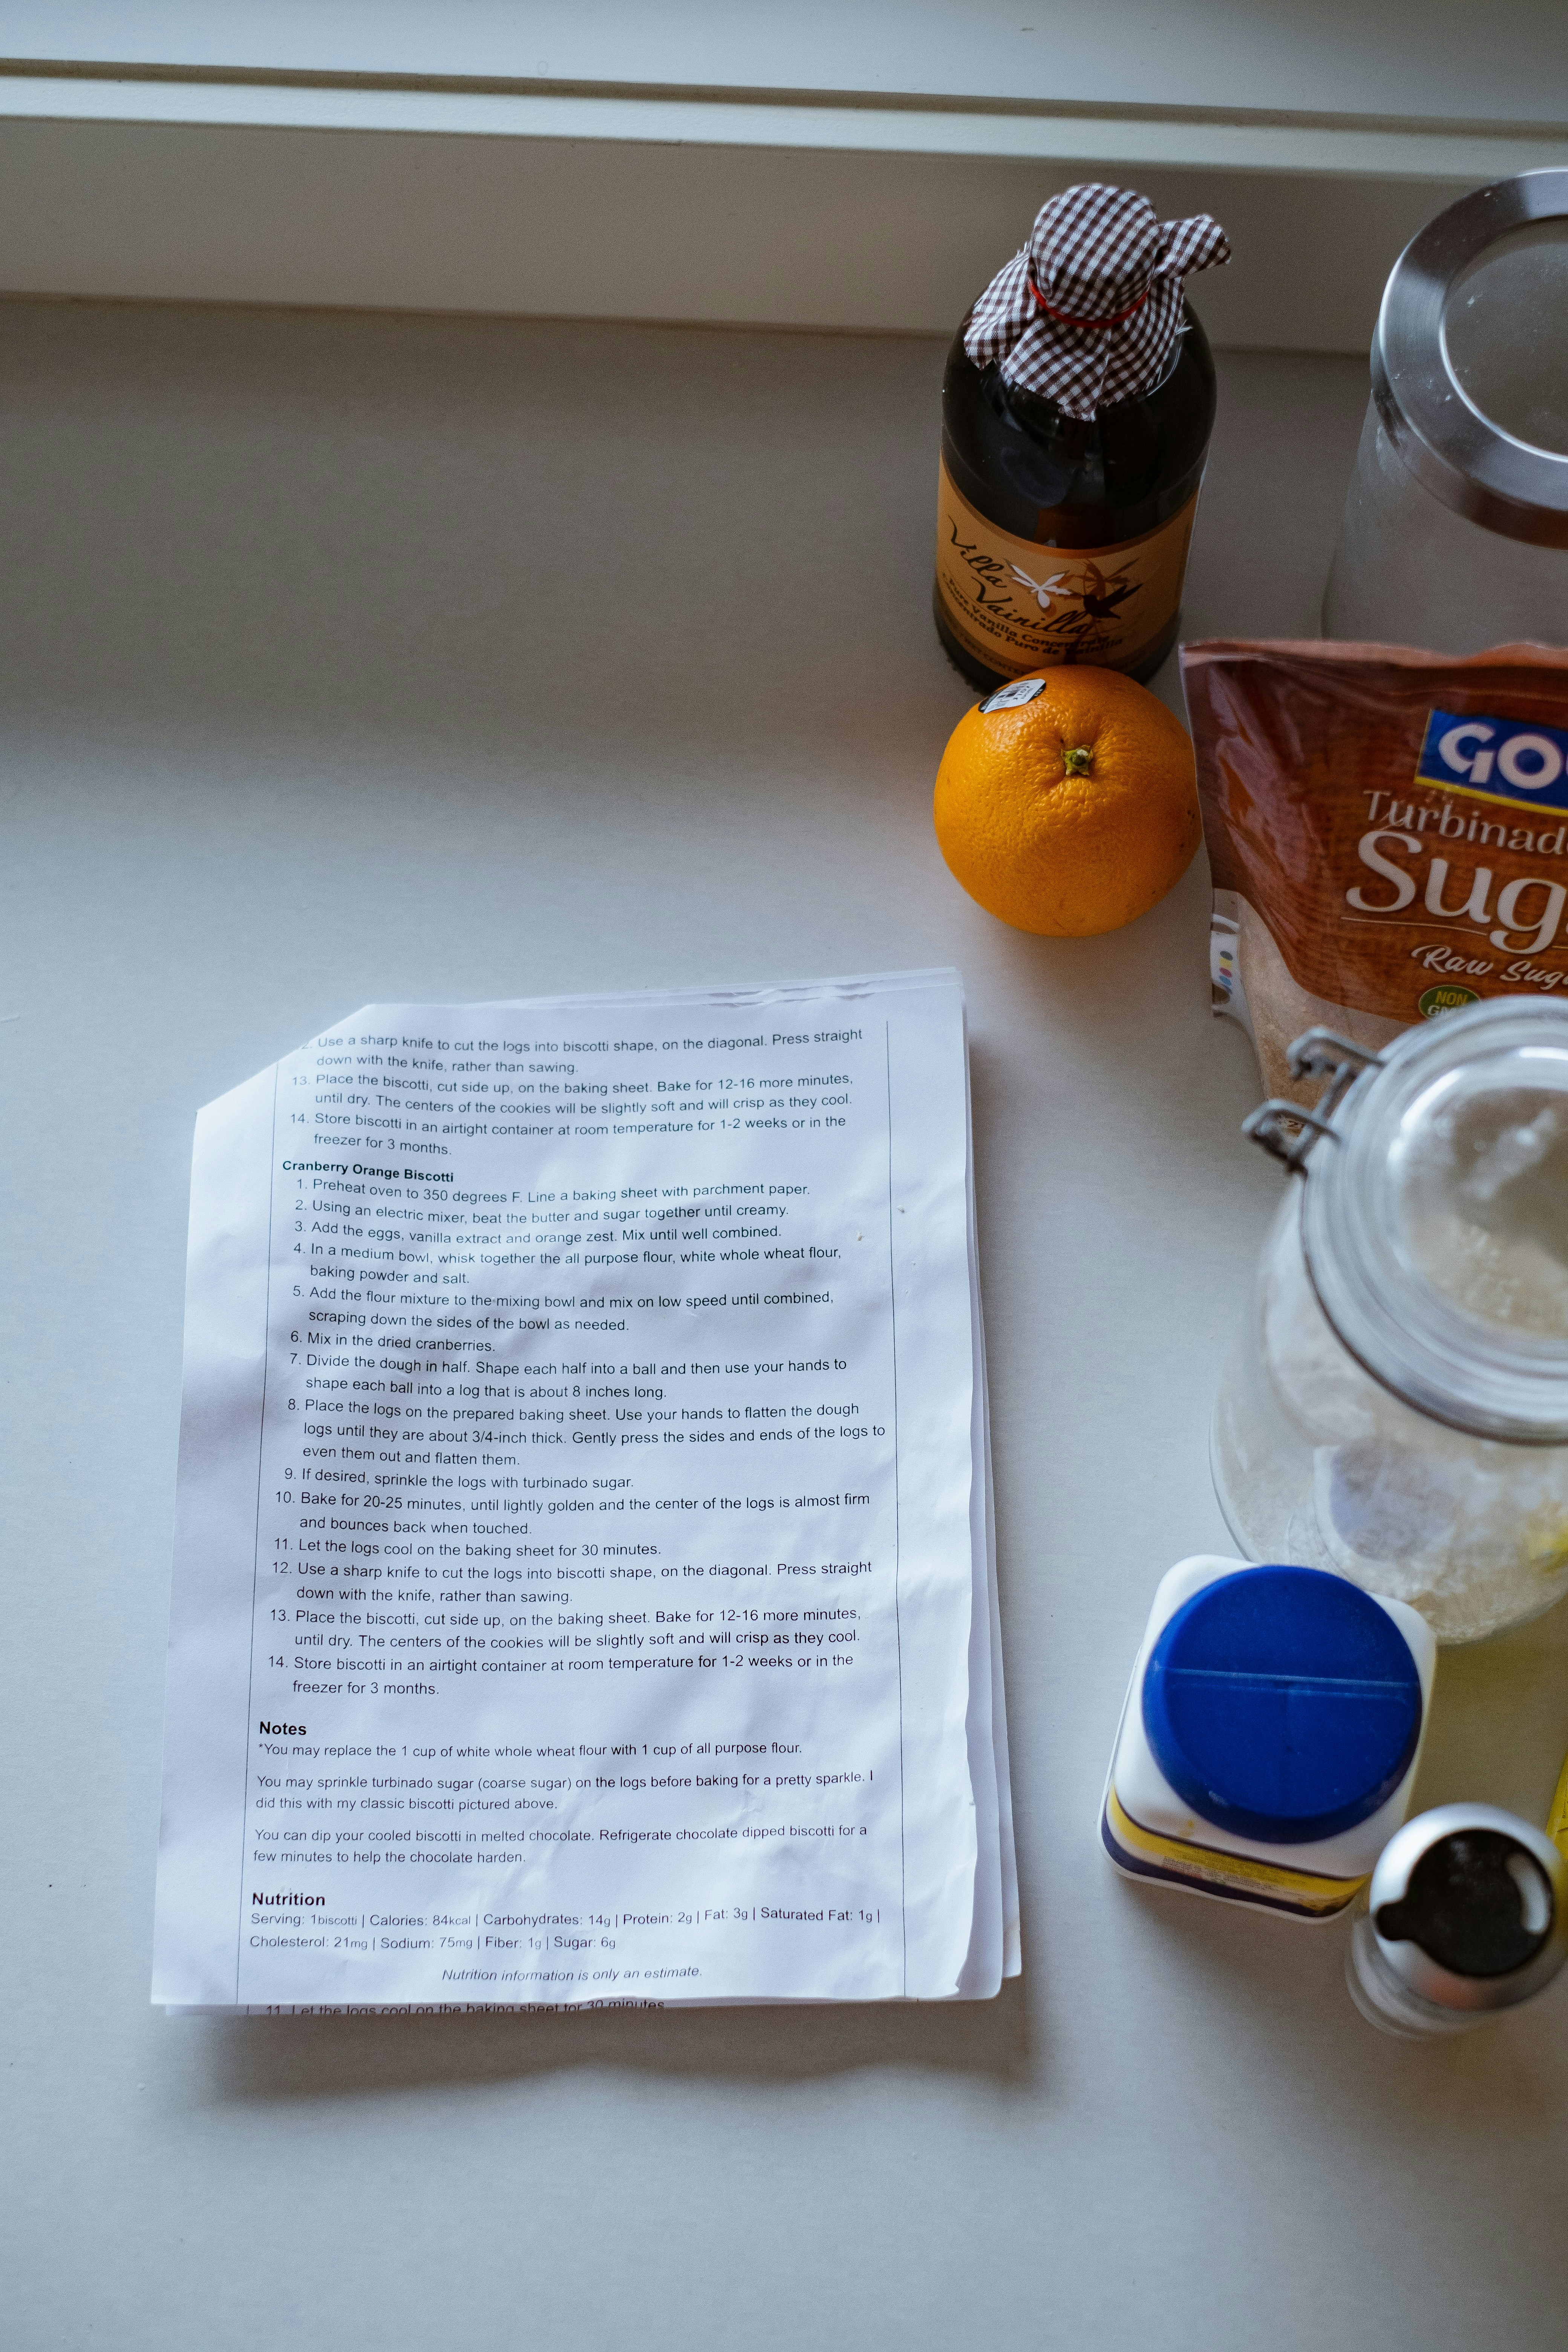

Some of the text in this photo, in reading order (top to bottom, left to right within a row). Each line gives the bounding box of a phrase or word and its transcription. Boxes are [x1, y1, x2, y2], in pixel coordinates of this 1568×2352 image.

[971, 576, 1090, 633] Vainilla
[972, 604, 1017, 638] Vanilla
[1005, 636, 1038, 652] Puro
[1043, 646, 1060, 655] de
[1438, 721, 1568, 789] GO
[1363, 790, 1568, 855] Turbinad
[1345, 830, 1568, 955] Sug
[1410, 944, 1494, 975] Raw
[1435, 990, 1468, 1006] NON
[292, 1074, 853, 1096] 13. Place the biscotti, cut side up, on the baking sheet. Bake for 12-16 more minutes,
[282, 1160, 454, 1183] Cranberry Orange Biscotti
[297, 1178, 810, 1205] 1. Preheat oven to 350 degrees F. Line a baking sheet with parchment paper.
[294, 1220, 781, 1246] 3. Add the eggs, vanilla extract and orange zest. Mix until well combined.
[290, 1330, 495, 1352] 6. Mix in the dried cranberries.
[290, 1352, 847, 1377] 7. Divide the dough in half. Shape each half into a ball and then use your hands to
[302, 1447, 520, 1465] even them out and flatten them.
[274, 1537, 661, 1559] 11. Let the logs cool on the baking sheet for 30 minutes.
[259, 1721, 307, 1736] Notes
[256, 1797, 557, 1813] did this with my classic biscotti pictured above.
[253, 1850, 525, 1865] few minutes to help the chocolate harden.
[252, 1892, 326, 1906] Nutrition
[250, 1936, 328, 1948] Cholesterol:
[334, 1936, 368, 1950] 21mg
[380, 1937, 434, 1949] Sodium:
[440, 1937, 473, 1949] 75mg
[485, 1936, 521, 1949] Fiber:
[528, 1937, 541, 1949] 1g
[554, 1936, 596, 1951] Sugar:
[600, 1936, 616, 1950] 6g
[442, 1966, 702, 1982] Nutrition information is only an estimate.
